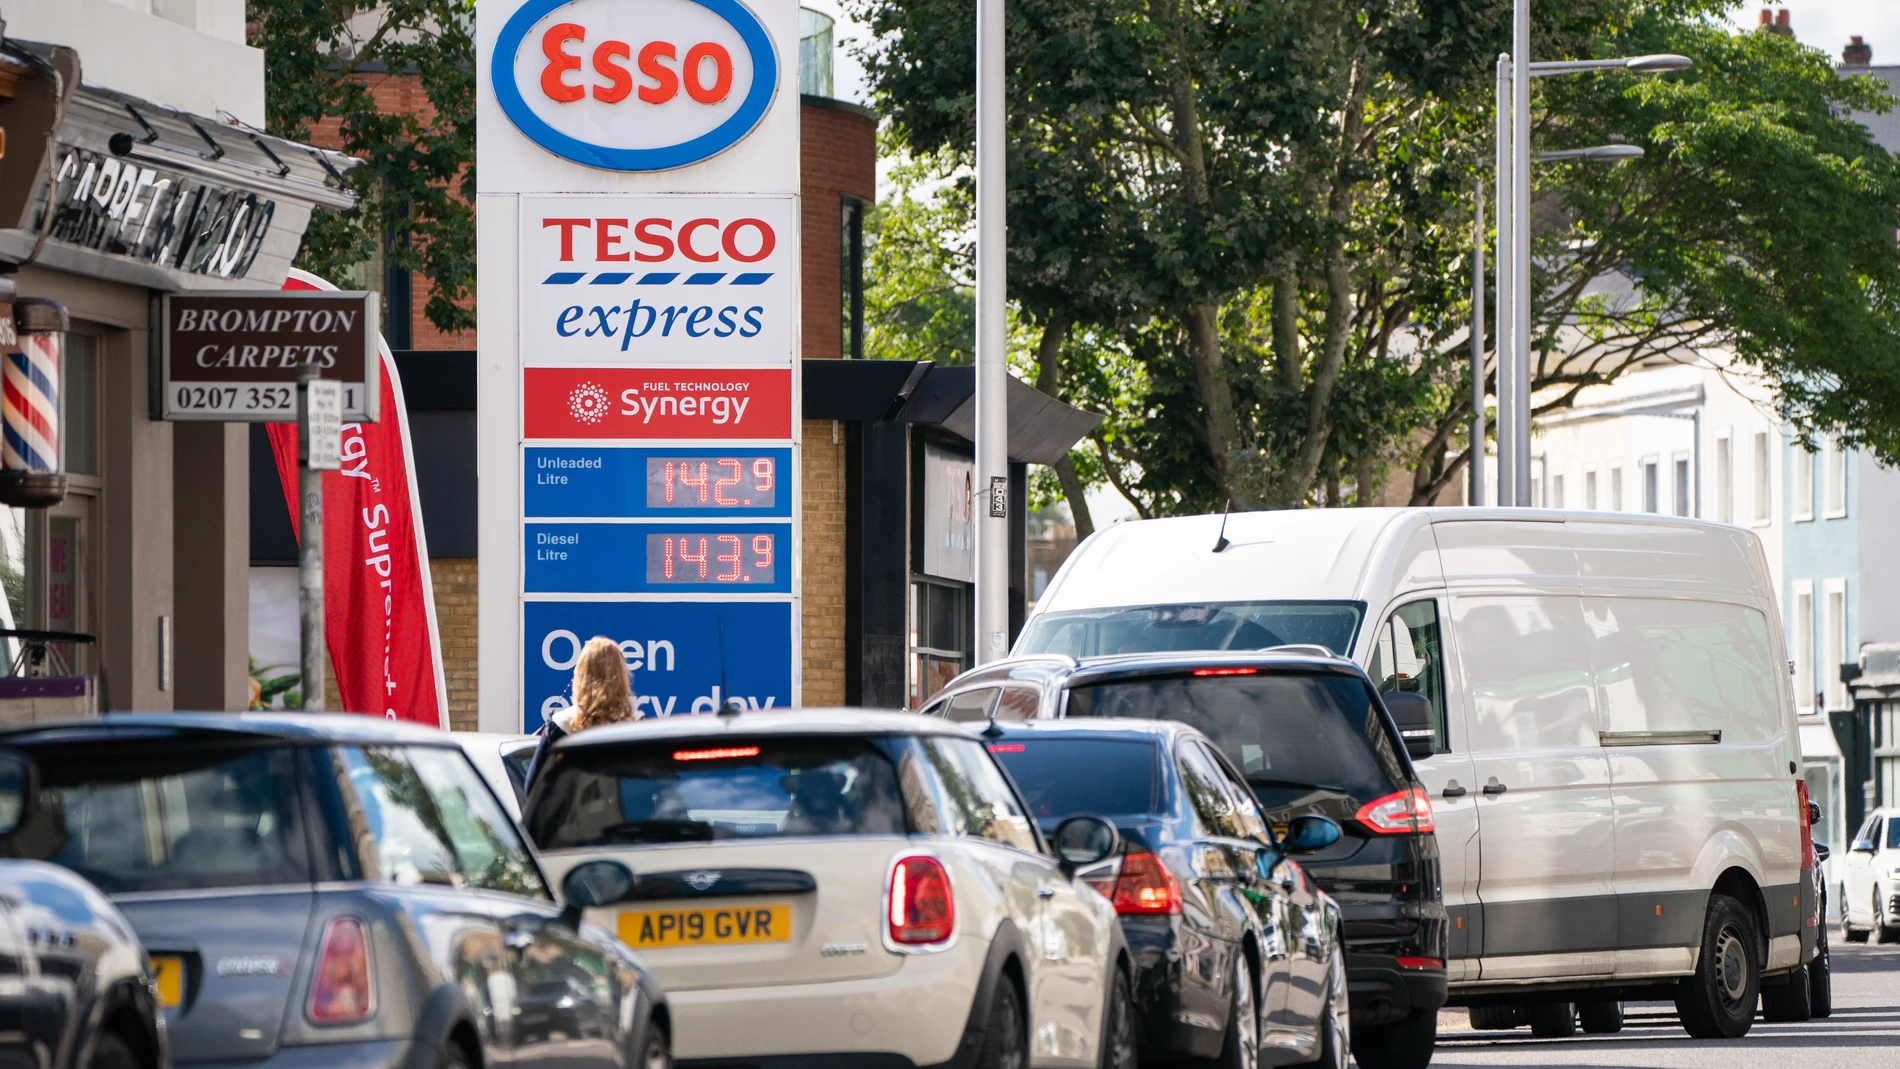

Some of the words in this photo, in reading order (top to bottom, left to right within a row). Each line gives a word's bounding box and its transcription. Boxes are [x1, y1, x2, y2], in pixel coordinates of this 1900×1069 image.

[542, 217, 776, 263] TESCO
[176, 309, 357, 333] BROMPTON
[556, 298, 765, 352] express
[196, 345, 339, 369] CARPETS
[177, 387, 238, 409] 0207
[246, 388, 291, 410] 352
[643, 382, 671, 391] FUEL
[673, 382, 750, 391] TECHNOLOGY
[620, 389, 750, 424] Synergy
[537, 457, 602, 469] Unleaded
[537, 473, 568, 485] Litre
[665, 458, 773, 506] 142.9
[537, 533, 579, 545] Diesel
[537, 549, 568, 561] Litre
[665, 535, 772, 582] 143.9
[541, 629, 675, 671] Oen
[638, 912, 704, 944] AP19
[714, 910, 772, 939] GVR
